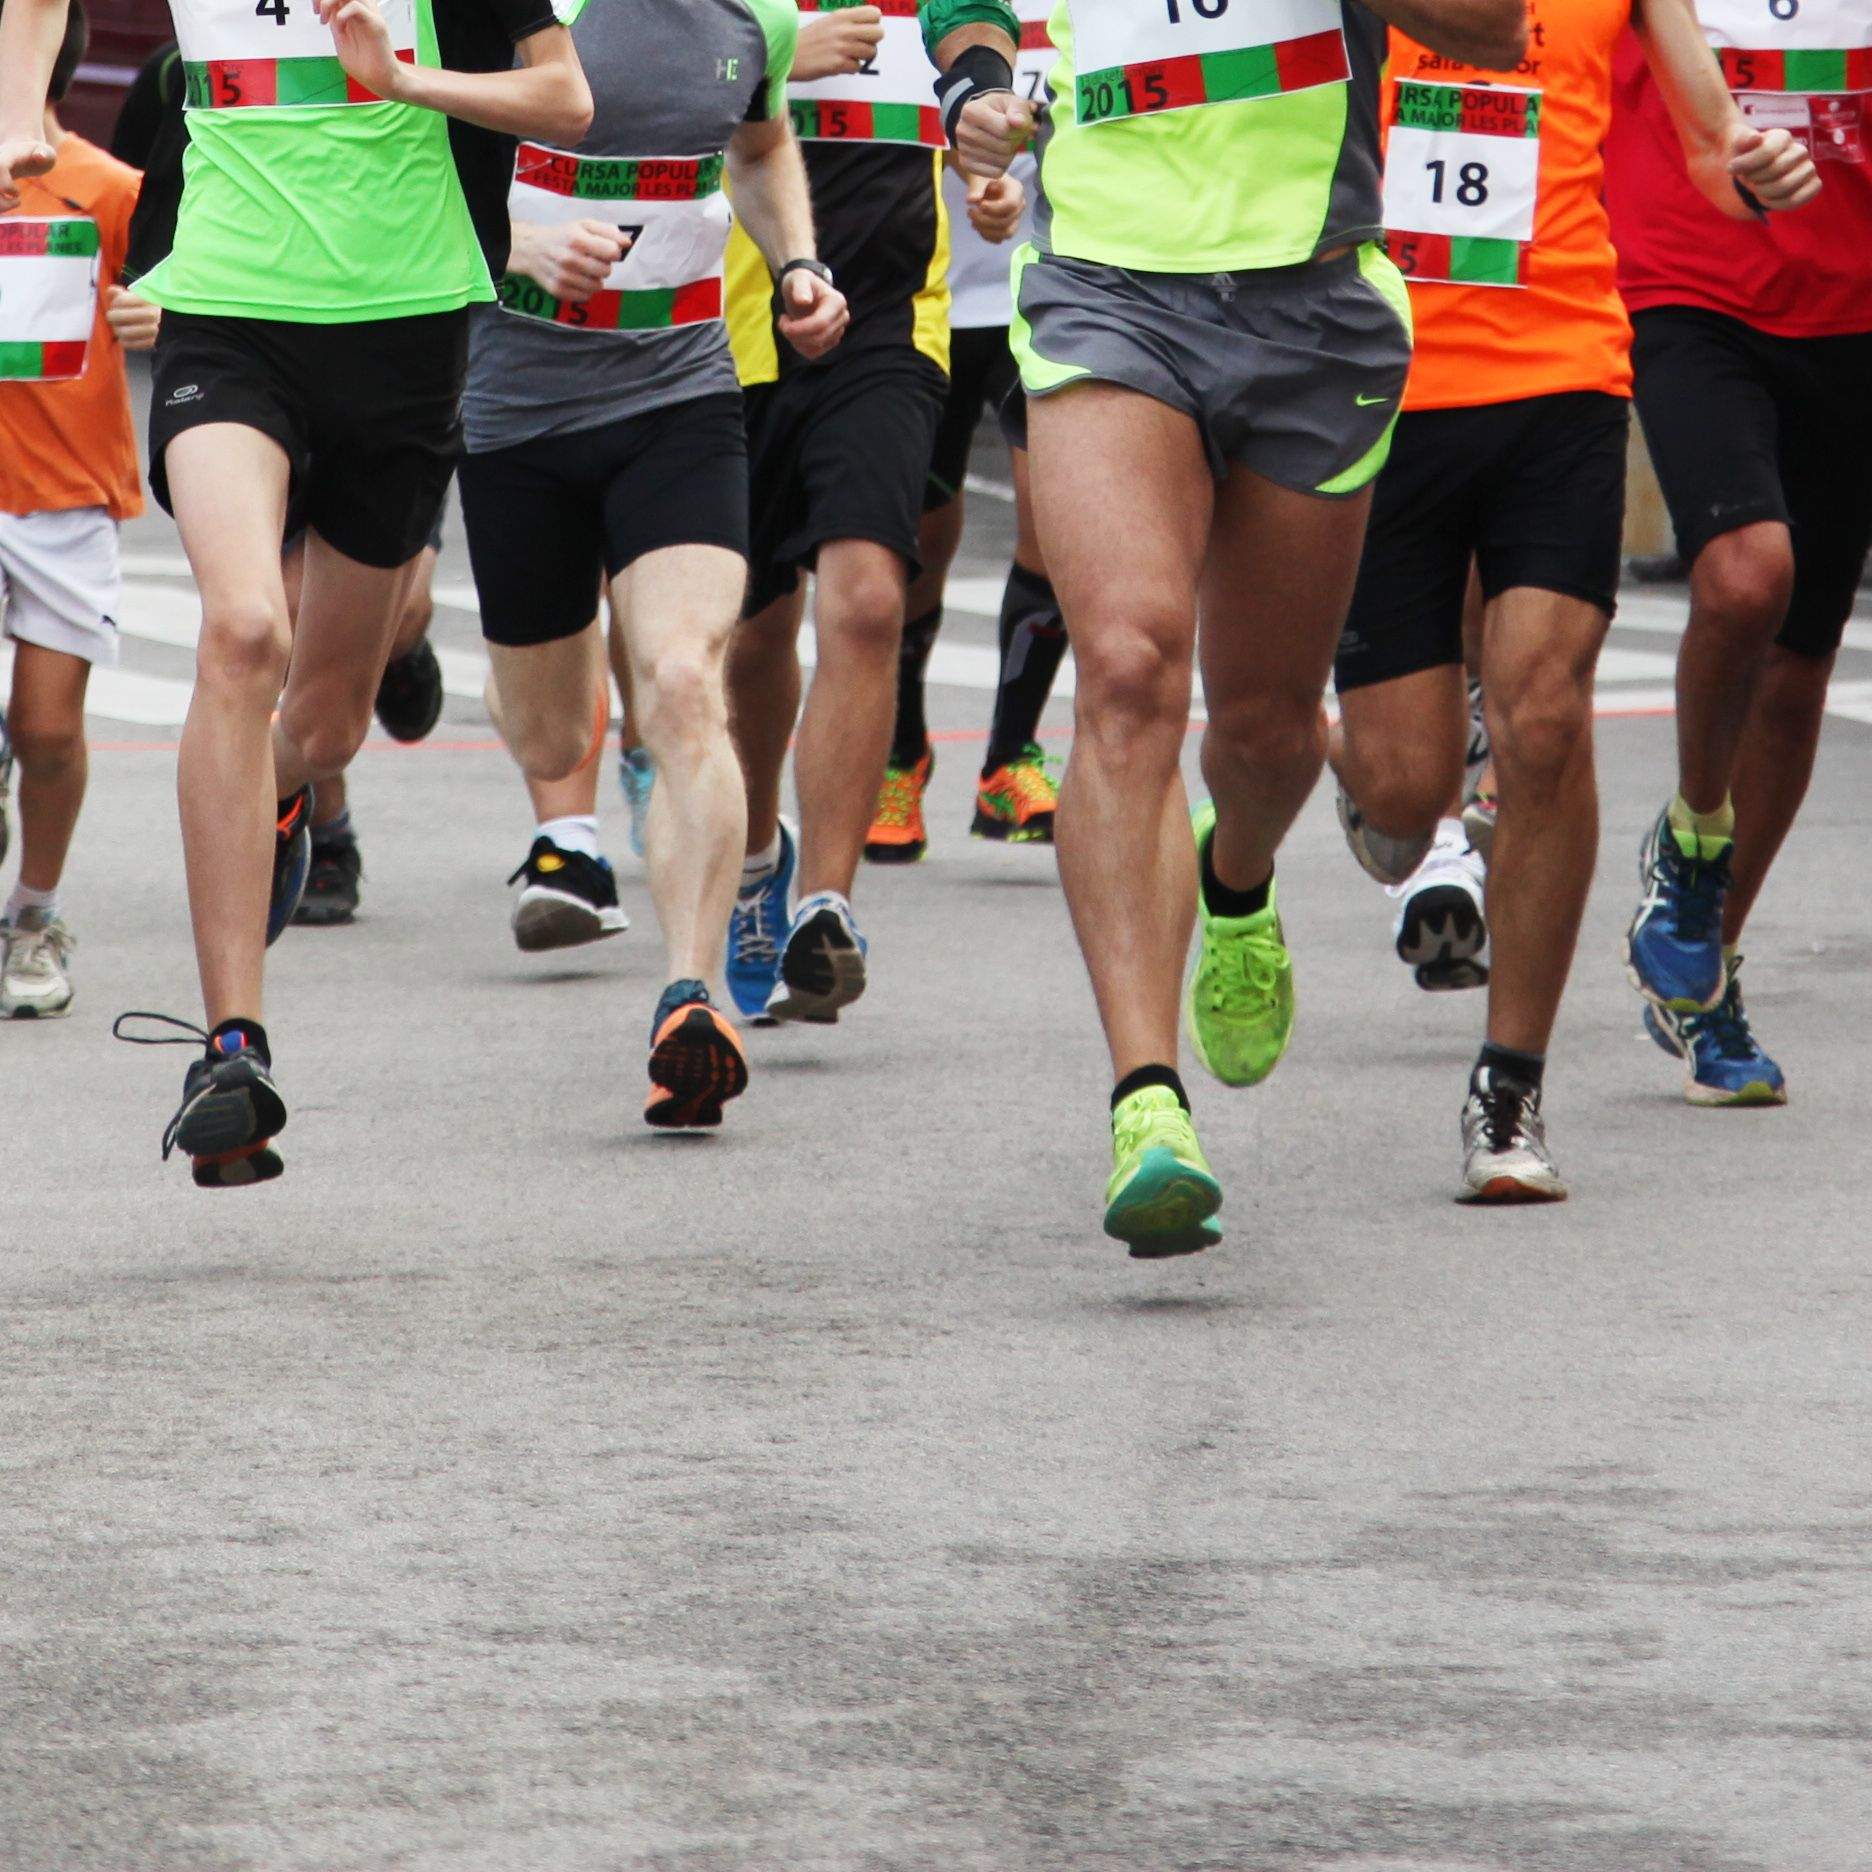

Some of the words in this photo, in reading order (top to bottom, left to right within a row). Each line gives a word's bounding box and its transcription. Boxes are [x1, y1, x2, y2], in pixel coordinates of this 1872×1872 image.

[1081, 74, 1168, 122] 2015
[1449, 89, 1538, 116] POPULA
[1471, 113, 1498, 132] LES
[551, 157, 621, 179] CURSA
[585, 181, 640, 197] MAJOR
[645, 182, 672, 197] LES
[1426, 160, 1489, 207] 18
[503, 279, 589, 326] 2015
